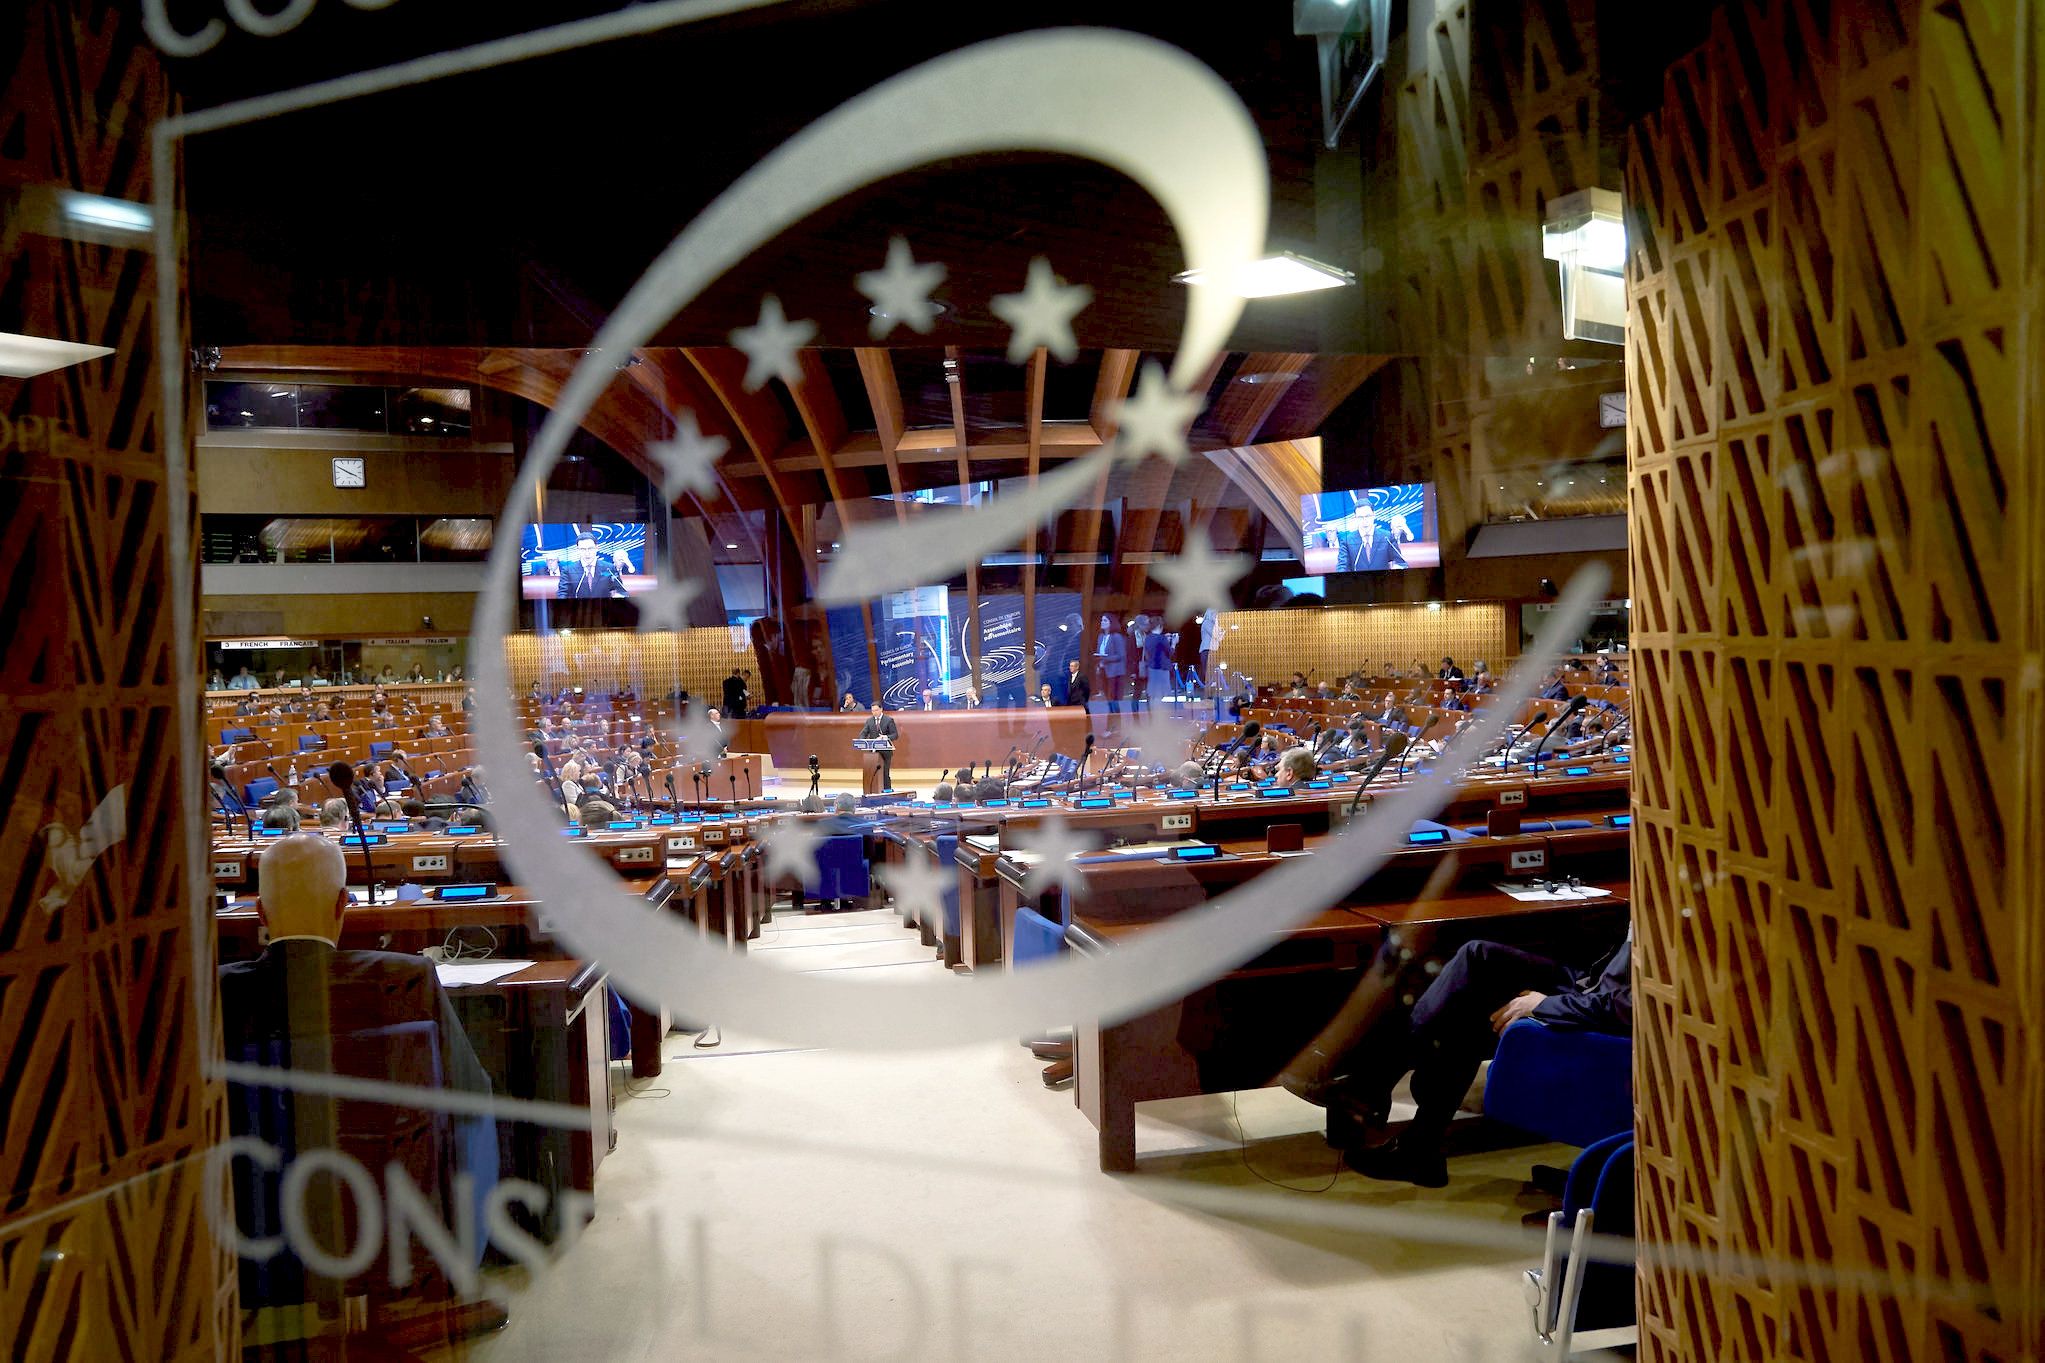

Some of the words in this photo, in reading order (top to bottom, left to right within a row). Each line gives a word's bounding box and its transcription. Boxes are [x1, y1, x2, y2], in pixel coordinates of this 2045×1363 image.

[983, 622, 1013, 634] Assemblée
[983, 627, 1022, 642] parlementaire
[880, 652, 914, 666] Parliamentary
[892, 658, 914, 669] Assembly
